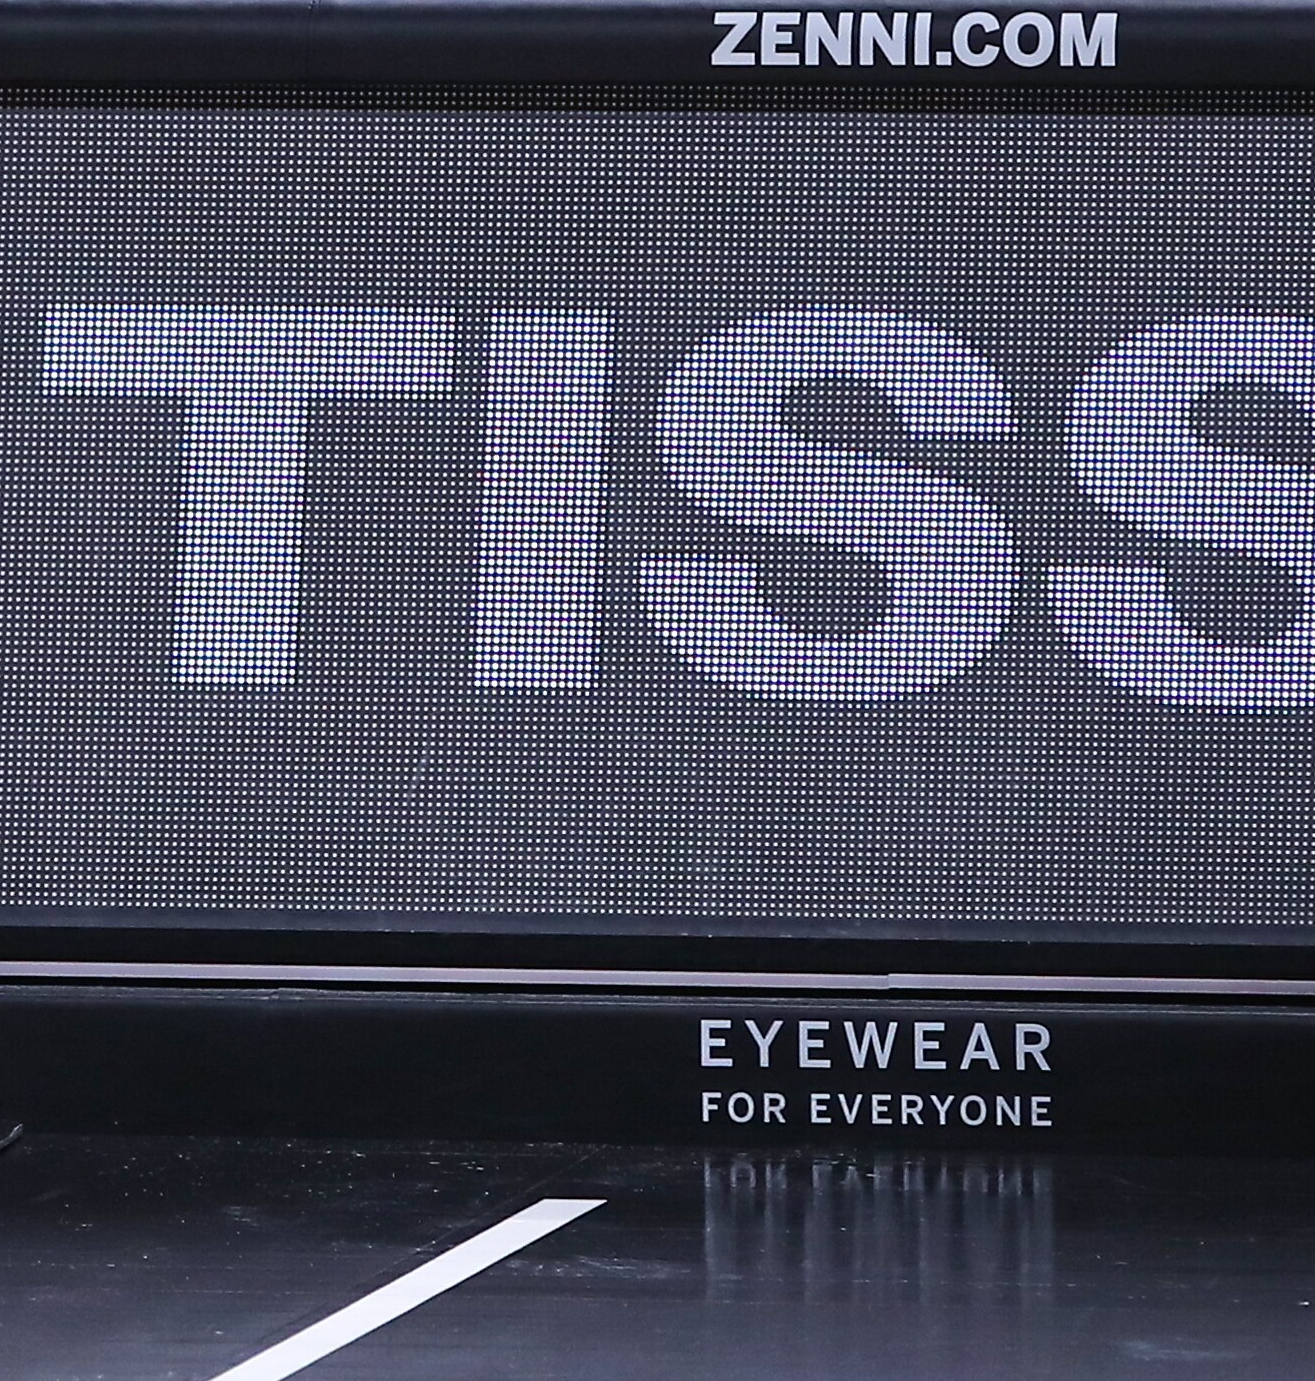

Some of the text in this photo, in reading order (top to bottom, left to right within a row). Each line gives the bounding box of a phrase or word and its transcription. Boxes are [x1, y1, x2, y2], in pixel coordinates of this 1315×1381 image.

[710, 11, 1118, 67] ZENNI.COM
[700, 1019, 1052, 1071] EYEWEAR
[701, 1091, 1053, 1127] FOR EVERYONE
